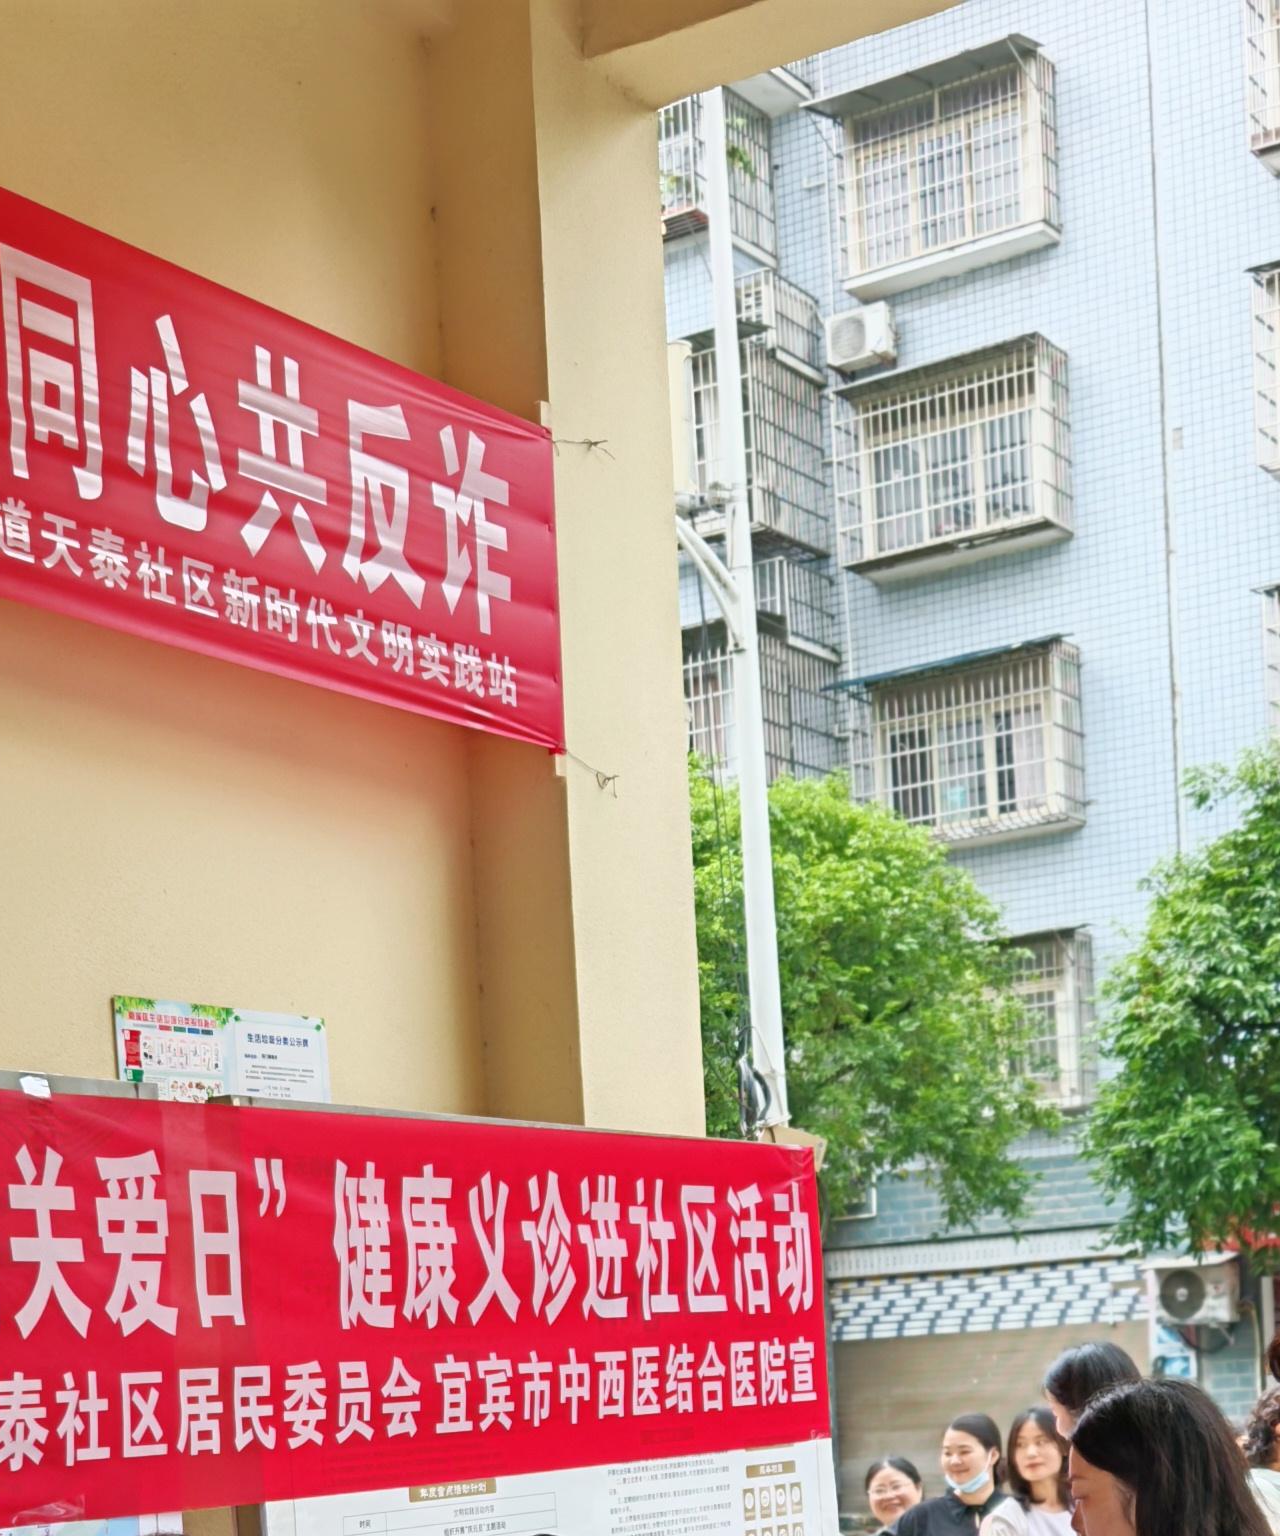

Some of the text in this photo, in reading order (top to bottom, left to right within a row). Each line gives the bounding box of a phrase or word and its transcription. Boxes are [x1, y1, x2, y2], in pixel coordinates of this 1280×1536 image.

[332, 1158, 815, 1329] 健康义诊进社区活动
